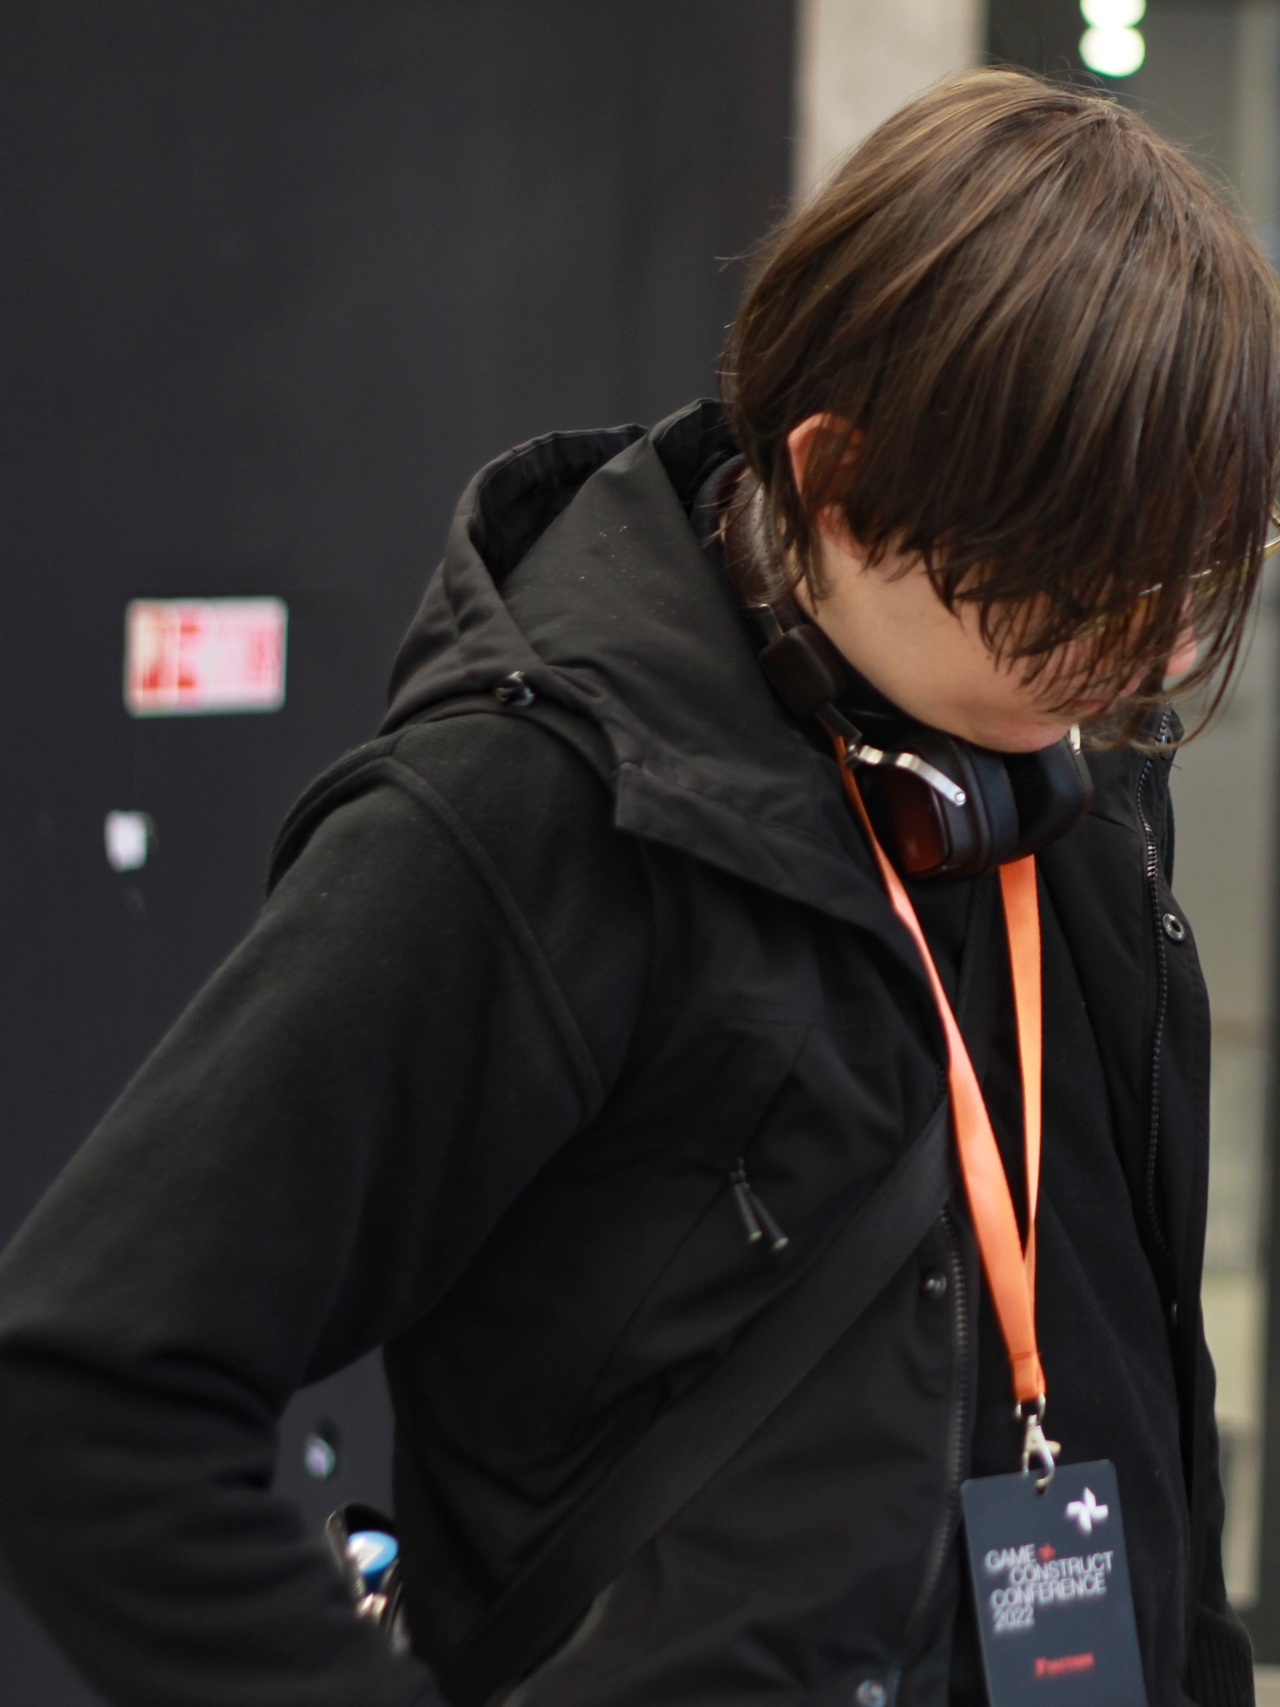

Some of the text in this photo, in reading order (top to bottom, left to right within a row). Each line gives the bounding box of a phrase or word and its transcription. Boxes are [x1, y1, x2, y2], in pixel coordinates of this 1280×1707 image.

[985, 1543, 1038, 1573] GAME
[1009, 1550, 1114, 1587] CONSTRUCT
[990, 1572, 1107, 1610] CONFERENCE
[993, 1604, 1035, 1632] 2022
